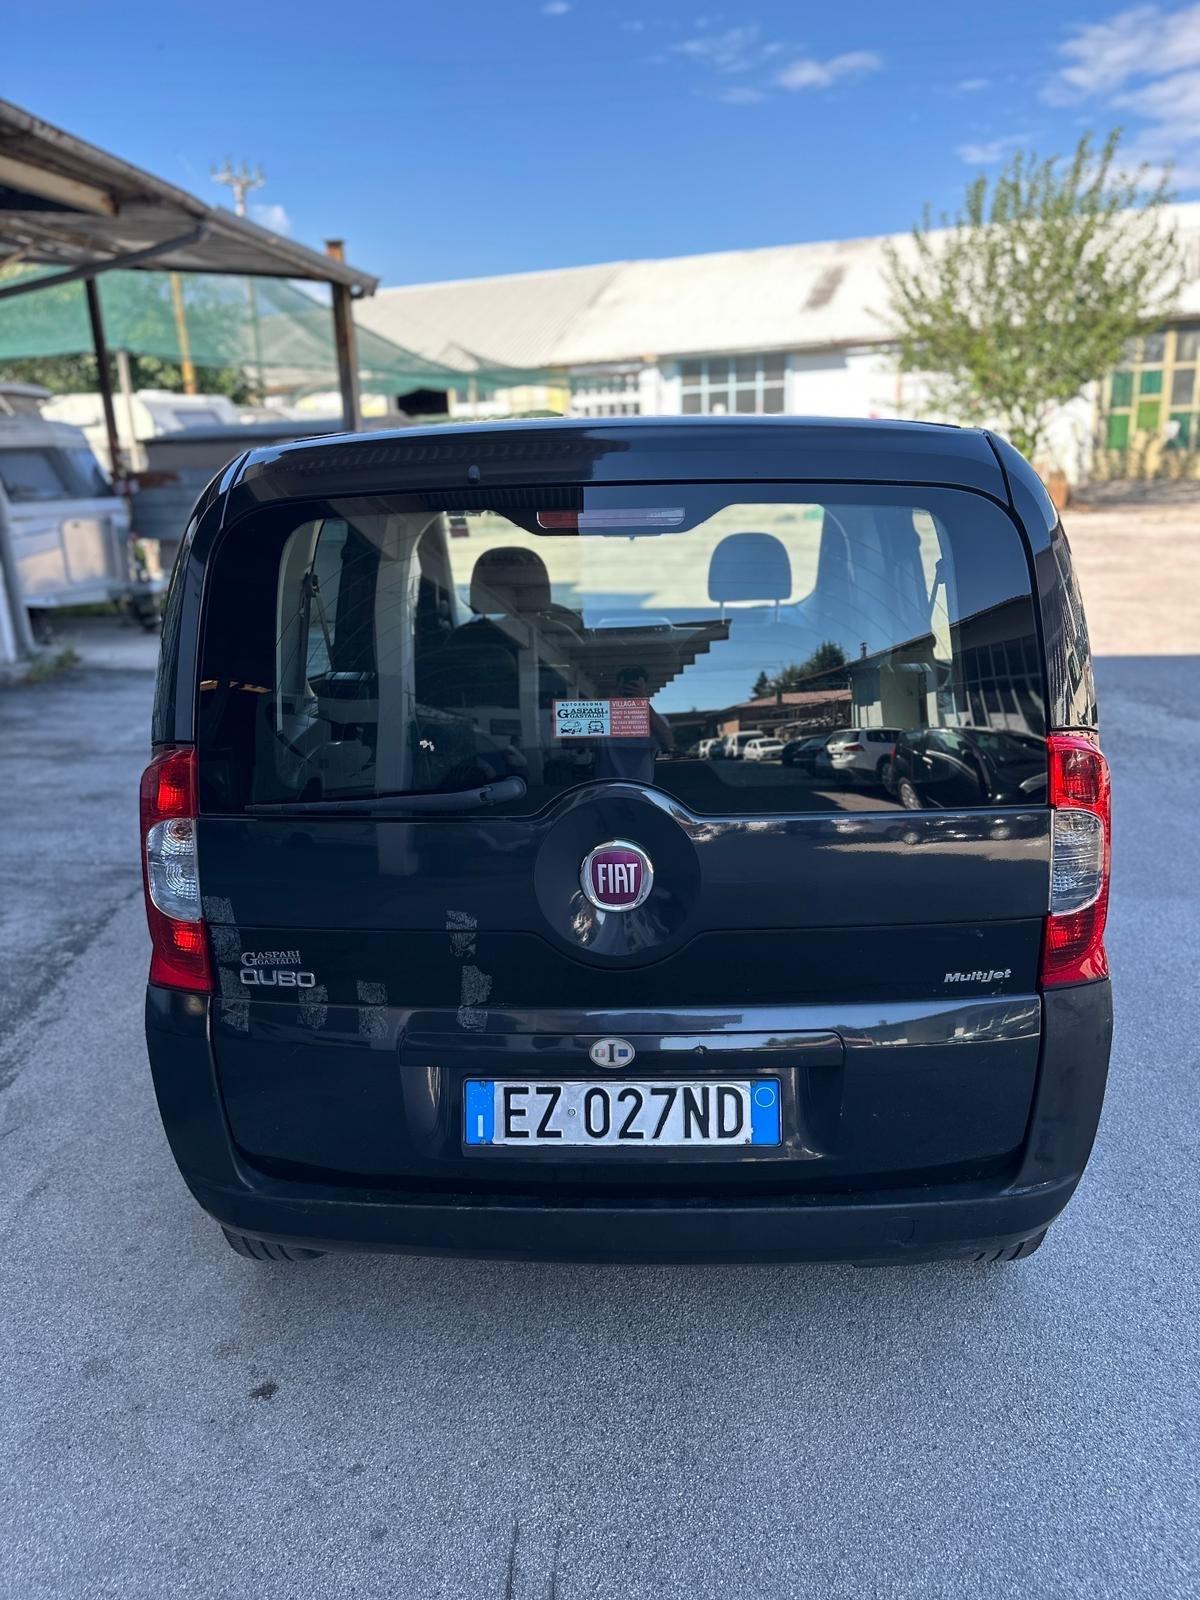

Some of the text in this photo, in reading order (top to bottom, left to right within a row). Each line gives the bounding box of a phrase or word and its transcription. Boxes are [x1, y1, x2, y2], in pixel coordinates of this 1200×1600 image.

[557, 708, 604, 718] GASPARI
[597, 863, 638, 894] FIAT
[240, 950, 300, 967] GASPARI
[240, 968, 316, 988] QUBO
[503, 1086, 744, 1139] EZ 027ND
